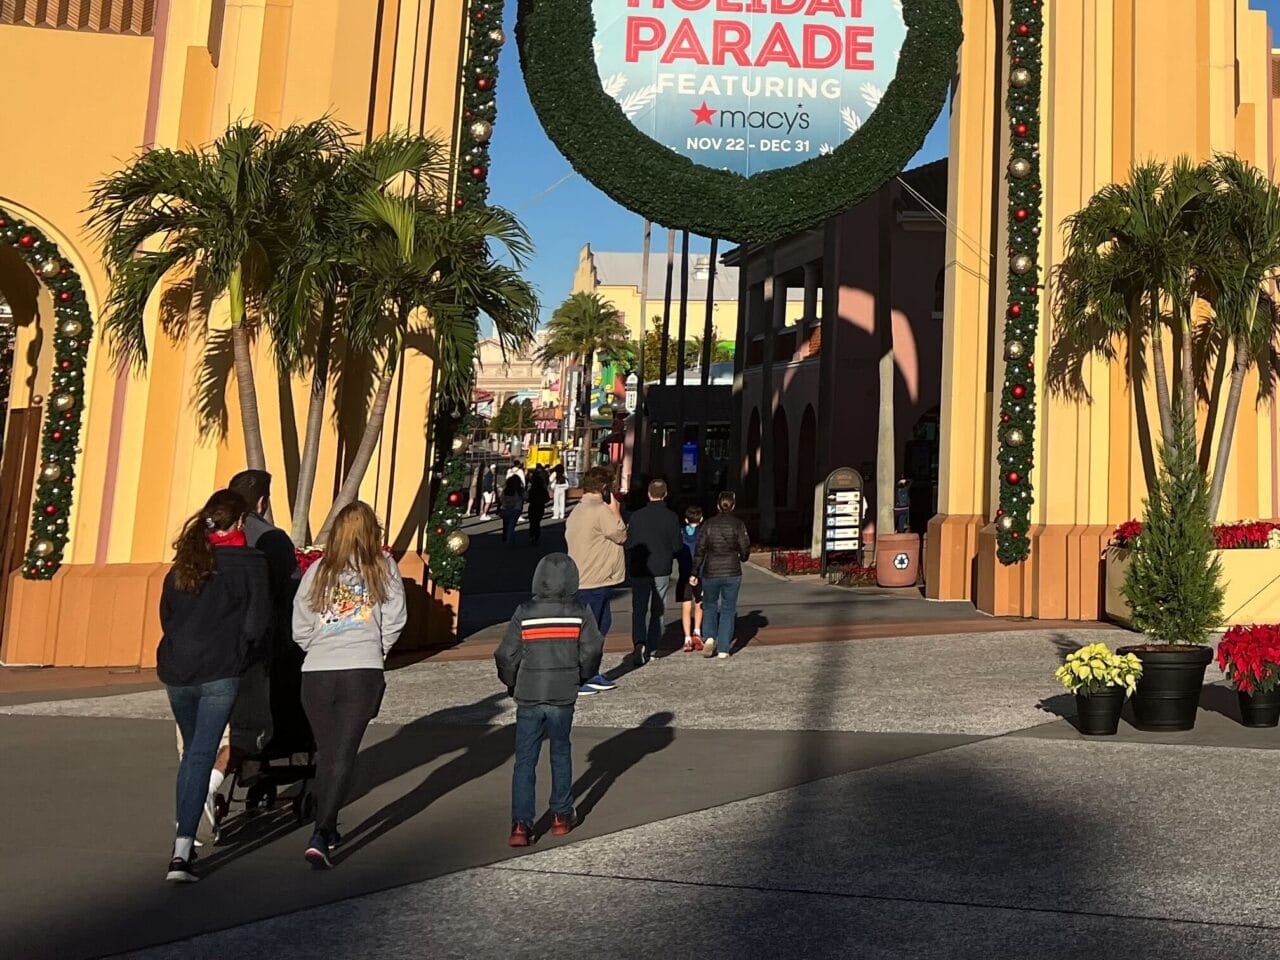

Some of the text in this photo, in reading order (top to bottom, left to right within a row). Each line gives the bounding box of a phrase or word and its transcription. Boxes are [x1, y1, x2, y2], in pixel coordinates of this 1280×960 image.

[624, 15, 876, 71] PARADE
[655, 73, 842, 99] FEATURING
[686, 137, 723, 151] NOV
[725, 138, 745, 151] 22
[759, 139, 792, 152] DEC
[793, 140, 810, 153] 31
